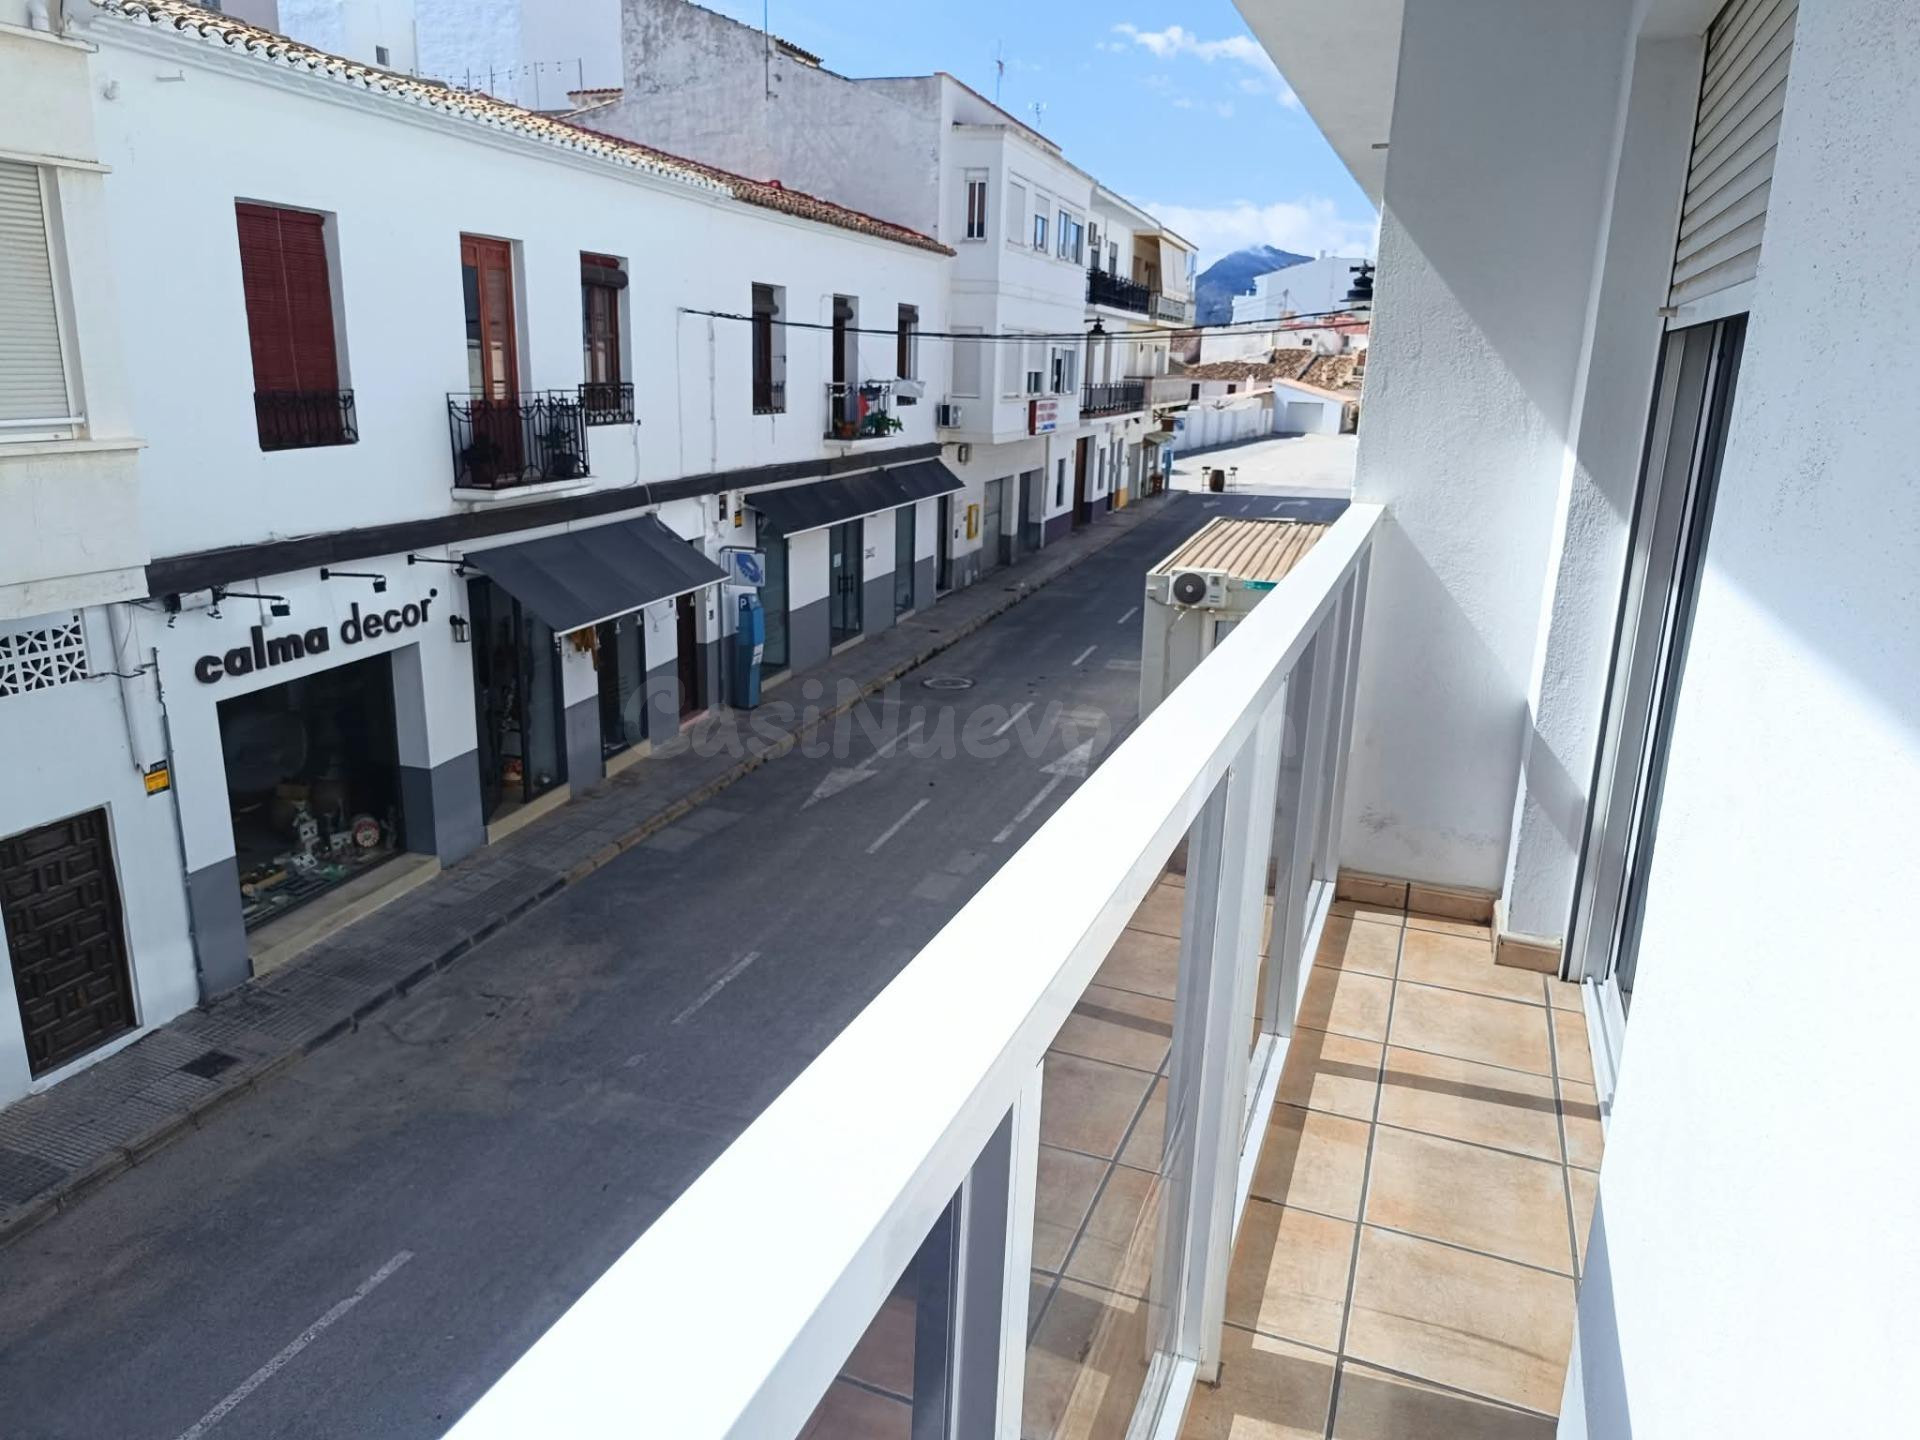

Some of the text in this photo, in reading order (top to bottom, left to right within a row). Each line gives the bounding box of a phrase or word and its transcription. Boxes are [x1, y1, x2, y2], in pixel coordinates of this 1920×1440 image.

[740, 598, 748, 609] P
[195, 601, 433, 684] calma decor
